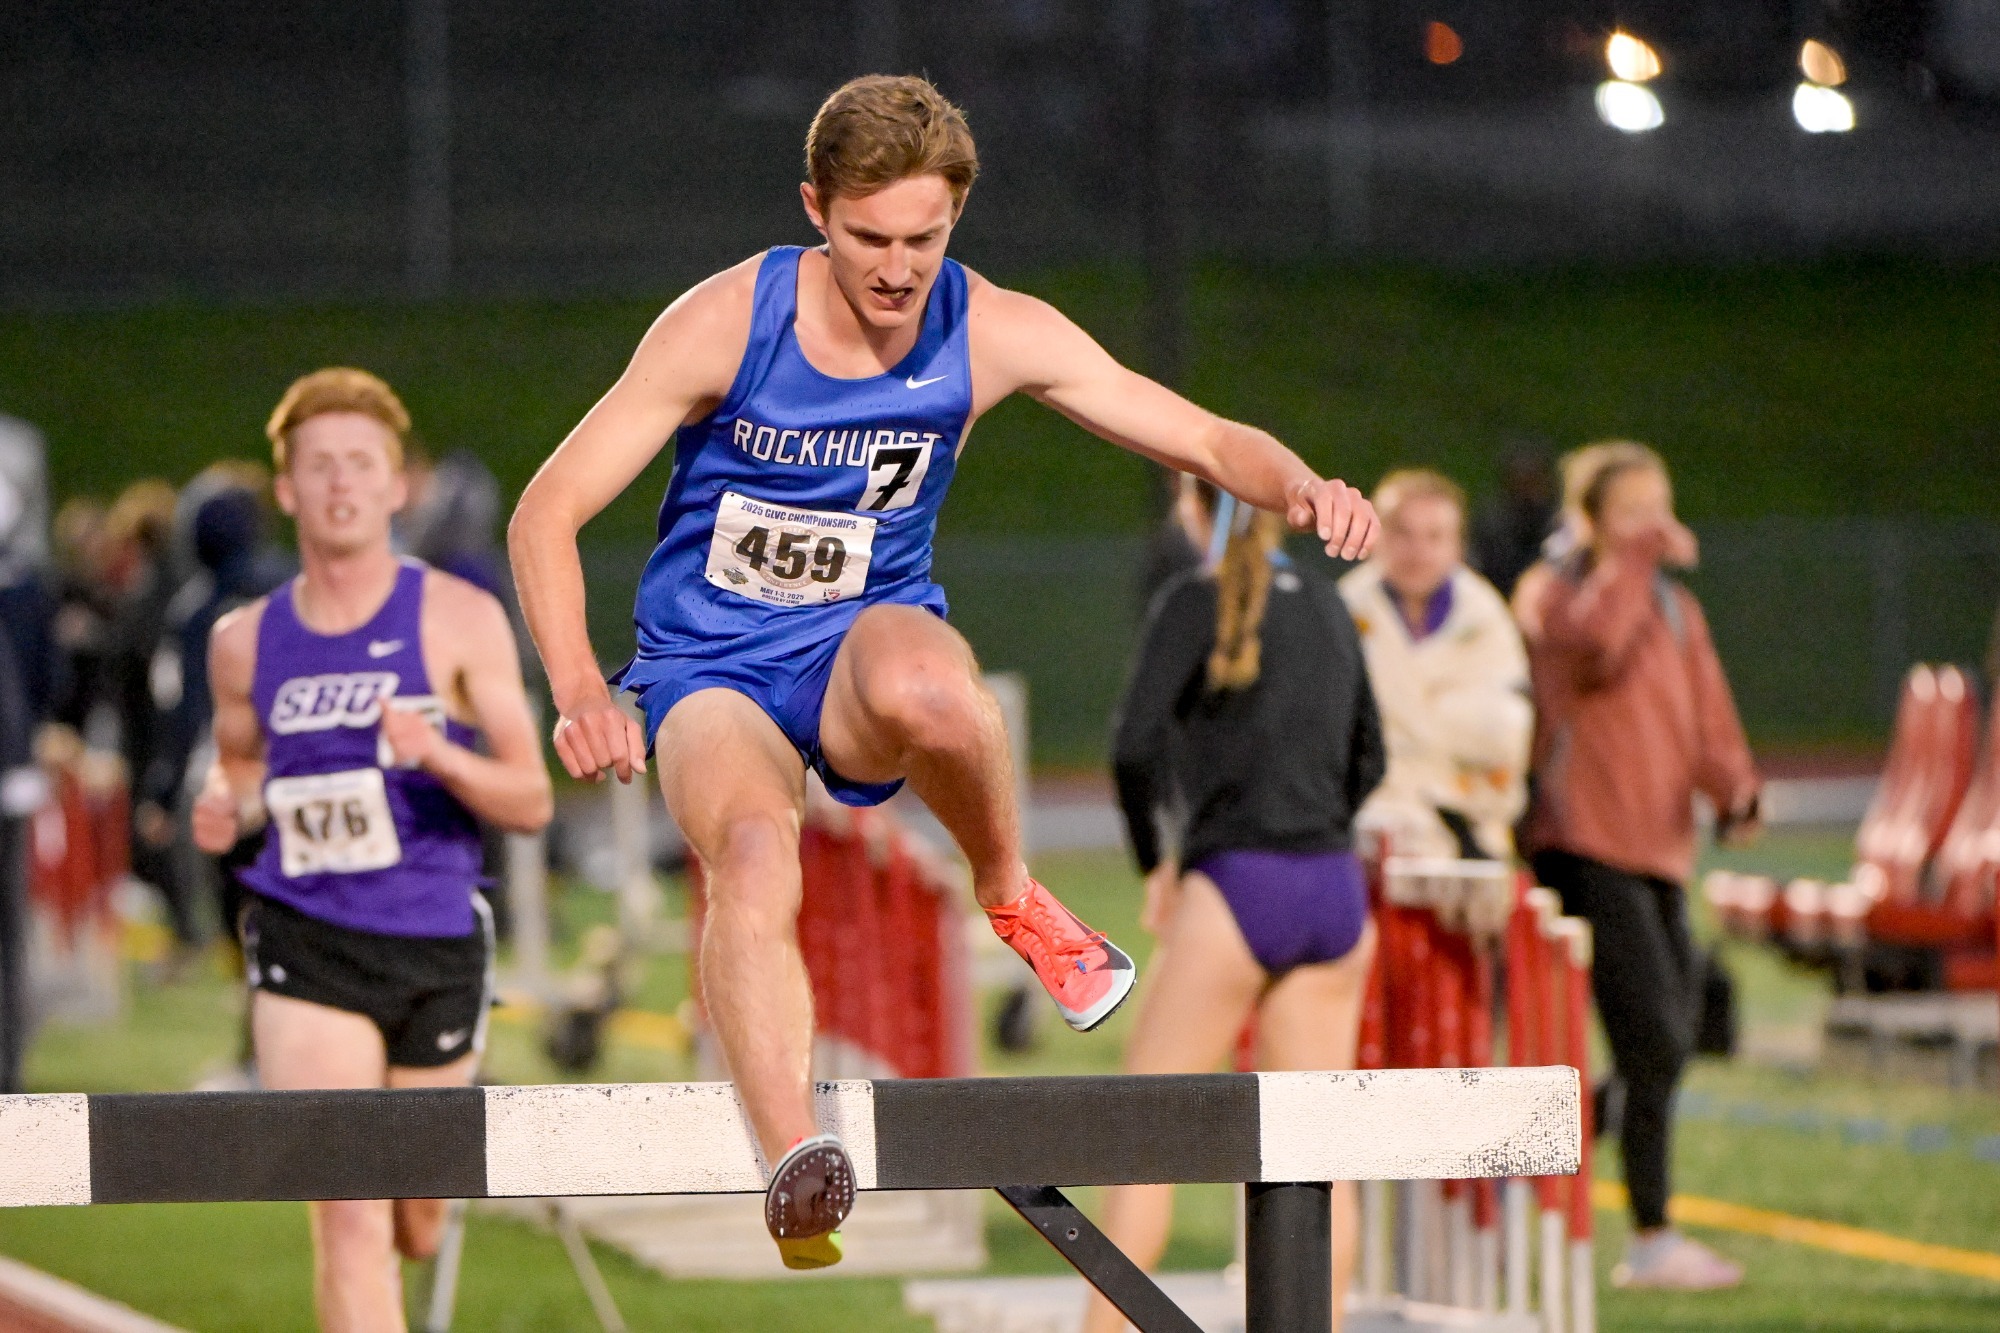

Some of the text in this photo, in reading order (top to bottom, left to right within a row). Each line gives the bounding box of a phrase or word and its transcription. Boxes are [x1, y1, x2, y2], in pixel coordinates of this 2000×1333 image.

[866, 446, 923, 511] 7
[741, 500, 858, 530] 2025 GLVC CHAMPIONSHIPS
[736, 525, 846, 583] 459
[760, 586, 774, 595] MAY
[271, 673, 398, 733] SBU
